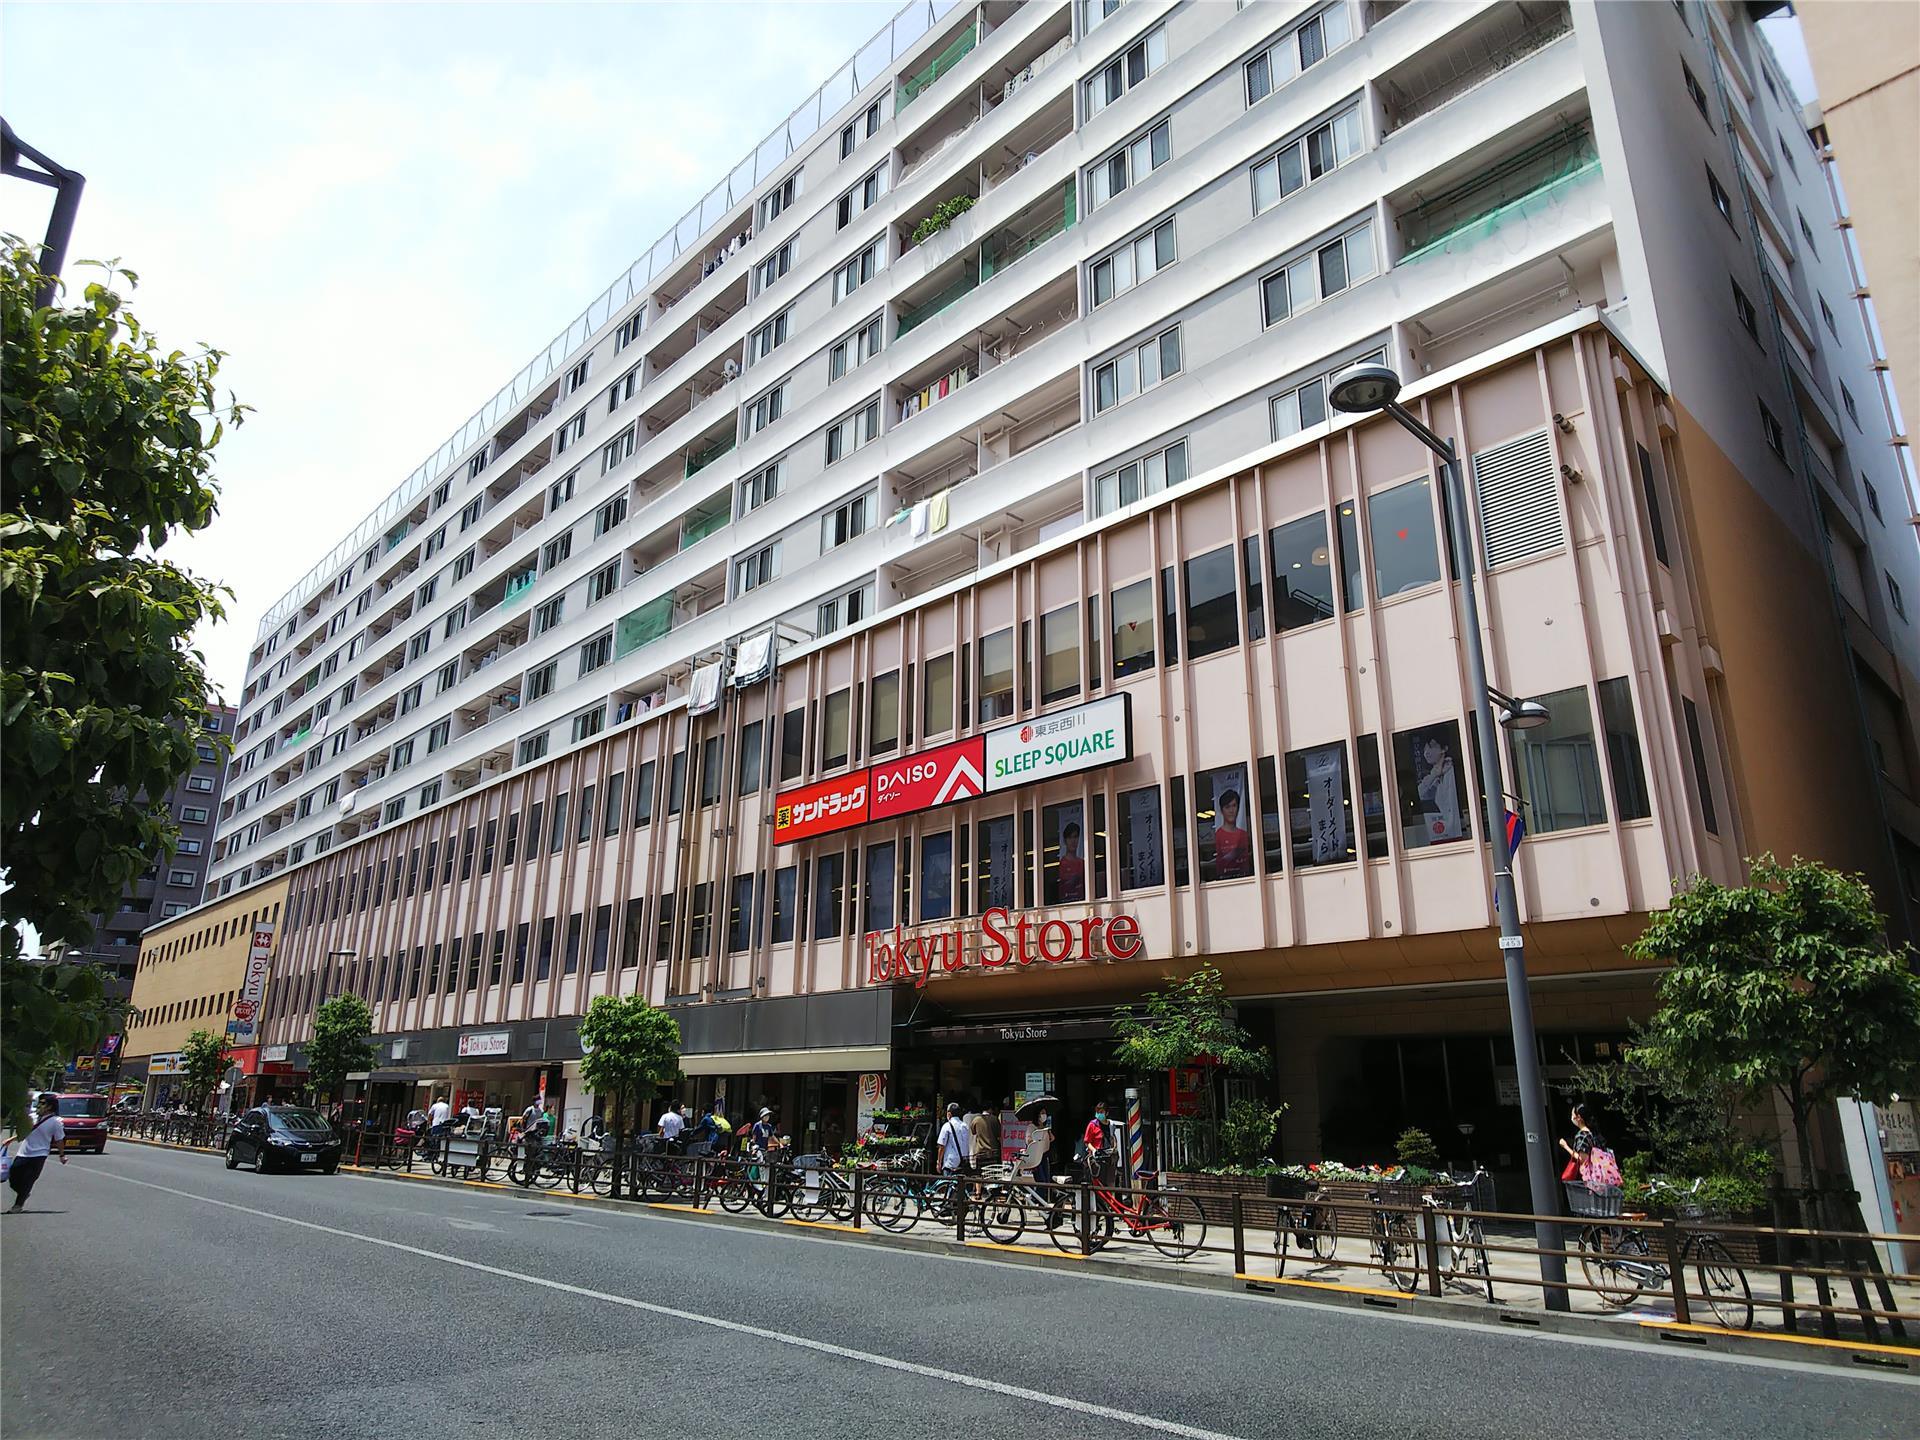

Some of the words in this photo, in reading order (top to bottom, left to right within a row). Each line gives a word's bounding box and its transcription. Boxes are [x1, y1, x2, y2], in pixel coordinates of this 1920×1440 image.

[1035, 712, 1086, 738] 東京西川
[995, 749, 1042, 778] SLEEP
[1044, 729, 1115, 765] SQUARE
[877, 761, 937, 792] DAISO
[777, 807, 790, 828] 薬
[792, 785, 867, 825] サンドラッグ
[877, 792, 901, 804] ダイソー
[1323, 776, 1339, 852] オーダーメイド
[1145, 813, 1157, 881] オーダーメイド
[1318, 819, 1329, 855] まくら
[1137, 852, 1147, 882] まくら
[865, 922, 968, 988] Tokyu
[980, 906, 1143, 967] Store
[247, 953, 269, 997] Tokyu
[469, 1037, 488, 1053] Tokyu
[489, 1036, 507, 1050] Store
[1000, 1028, 1025, 1041] Tokyu
[1025, 1027, 1048, 1039] Store
